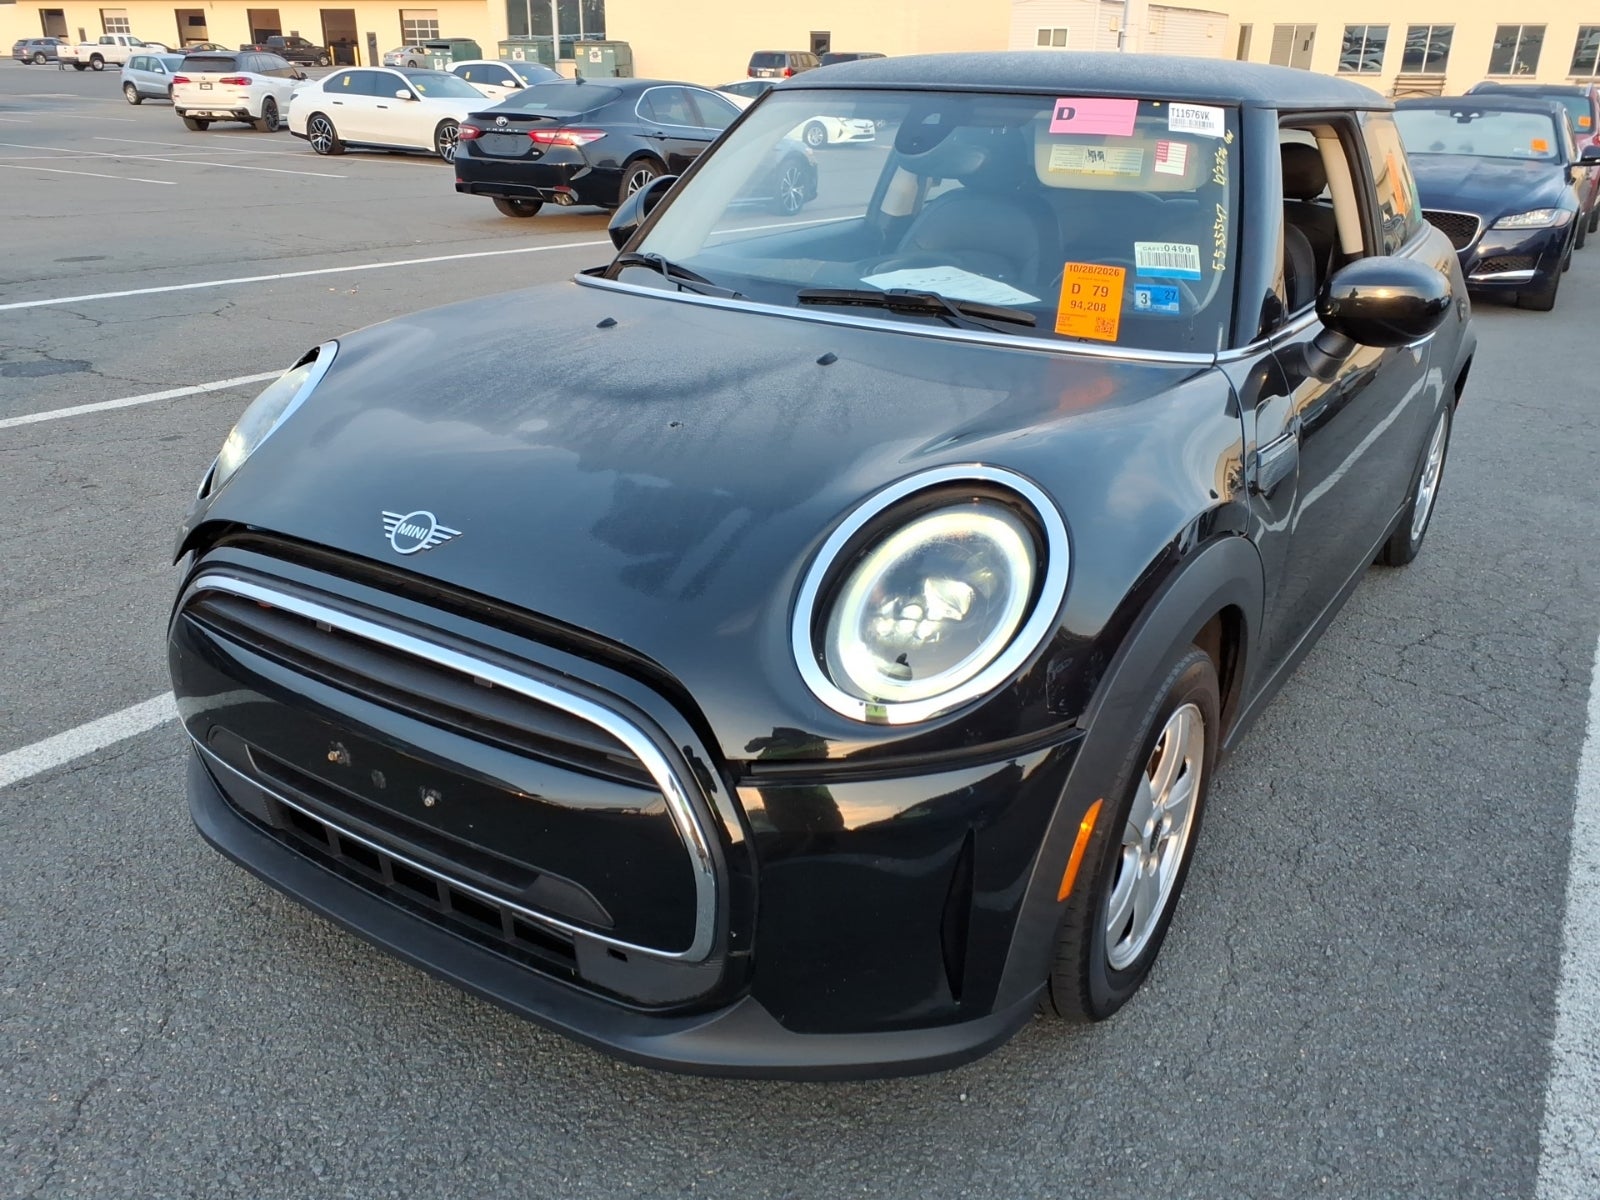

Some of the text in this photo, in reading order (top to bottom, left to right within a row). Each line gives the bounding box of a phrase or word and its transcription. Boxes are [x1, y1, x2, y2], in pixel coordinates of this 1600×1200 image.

[1055, 107, 1076, 121] D
[1171, 107, 1210, 120] T11676VK
[1068, 264, 1120, 277] 10/28/2026
[1071, 283, 1109, 298] D 79
[1140, 292, 1148, 305] 3
[1070, 300, 1107, 312] 94,208
[397, 522, 429, 540] MINI
